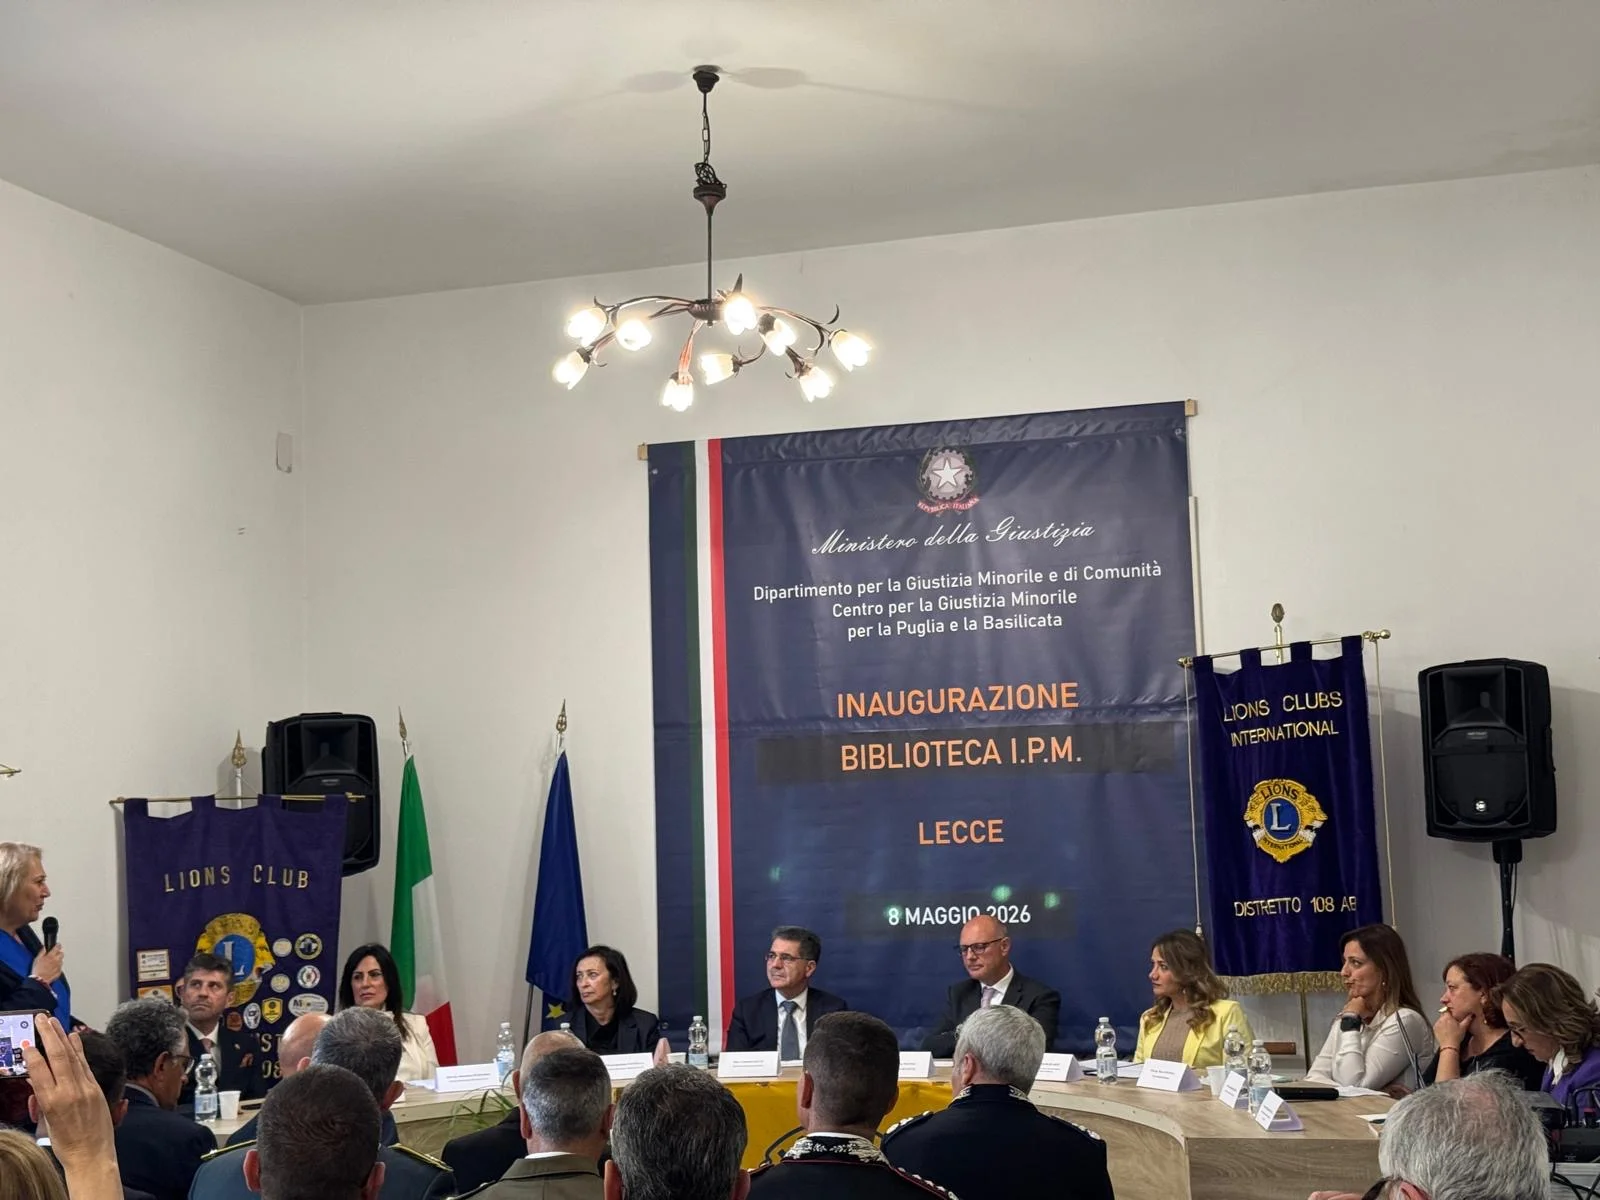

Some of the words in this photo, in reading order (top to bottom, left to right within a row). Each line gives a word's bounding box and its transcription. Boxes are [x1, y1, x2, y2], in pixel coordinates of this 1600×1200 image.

[811, 528, 918, 554] Ministero
[924, 522, 979, 546] della
[985, 515, 1096, 547] Giustizia
[753, 581, 852, 603] Dipartimento
[857, 581, 883, 597] per
[887, 578, 901, 592] la
[906, 573, 973, 591] Giustizia
[978, 569, 1043, 586] Minorile
[1049, 571, 1058, 583] e
[1063, 566, 1078, 581] di
[1083, 560, 1162, 580] Comunità
[832, 603, 884, 618] Centro
[888, 602, 914, 618] per
[919, 597, 933, 612] la
[938, 593, 1006, 611] Giustizia
[1011, 589, 1078, 607] Minorile
[847, 625, 873, 642] per
[878, 622, 891, 637] la
[897, 619, 945, 637] Puglia
[949, 621, 959, 632] e
[963, 616, 978, 631] la
[983, 613, 1063, 630] Basilicata
[837, 682, 1079, 719] INAUGURAZIONE
[1223, 699, 1270, 722] LIONS
[1282, 691, 1343, 712] CLUBS
[1231, 720, 1339, 747] INTERNATIONAL
[841, 738, 1002, 772] BIBLIOTECA
[1011, 736, 1082, 764] I.P.M.
[1261, 783, 1300, 800] LIONS
[1270, 803, 1292, 831] L
[918, 818, 1004, 846] LECCE
[164, 865, 231, 893] LIONS
[253, 864, 310, 889] CLUB
[888, 907, 900, 926] 8
[905, 905, 981, 926] MAGGIO
[986, 904, 1031, 924] 2026
[1234, 896, 1302, 916] DISTRETTO
[1310, 896, 1335, 913] 108
